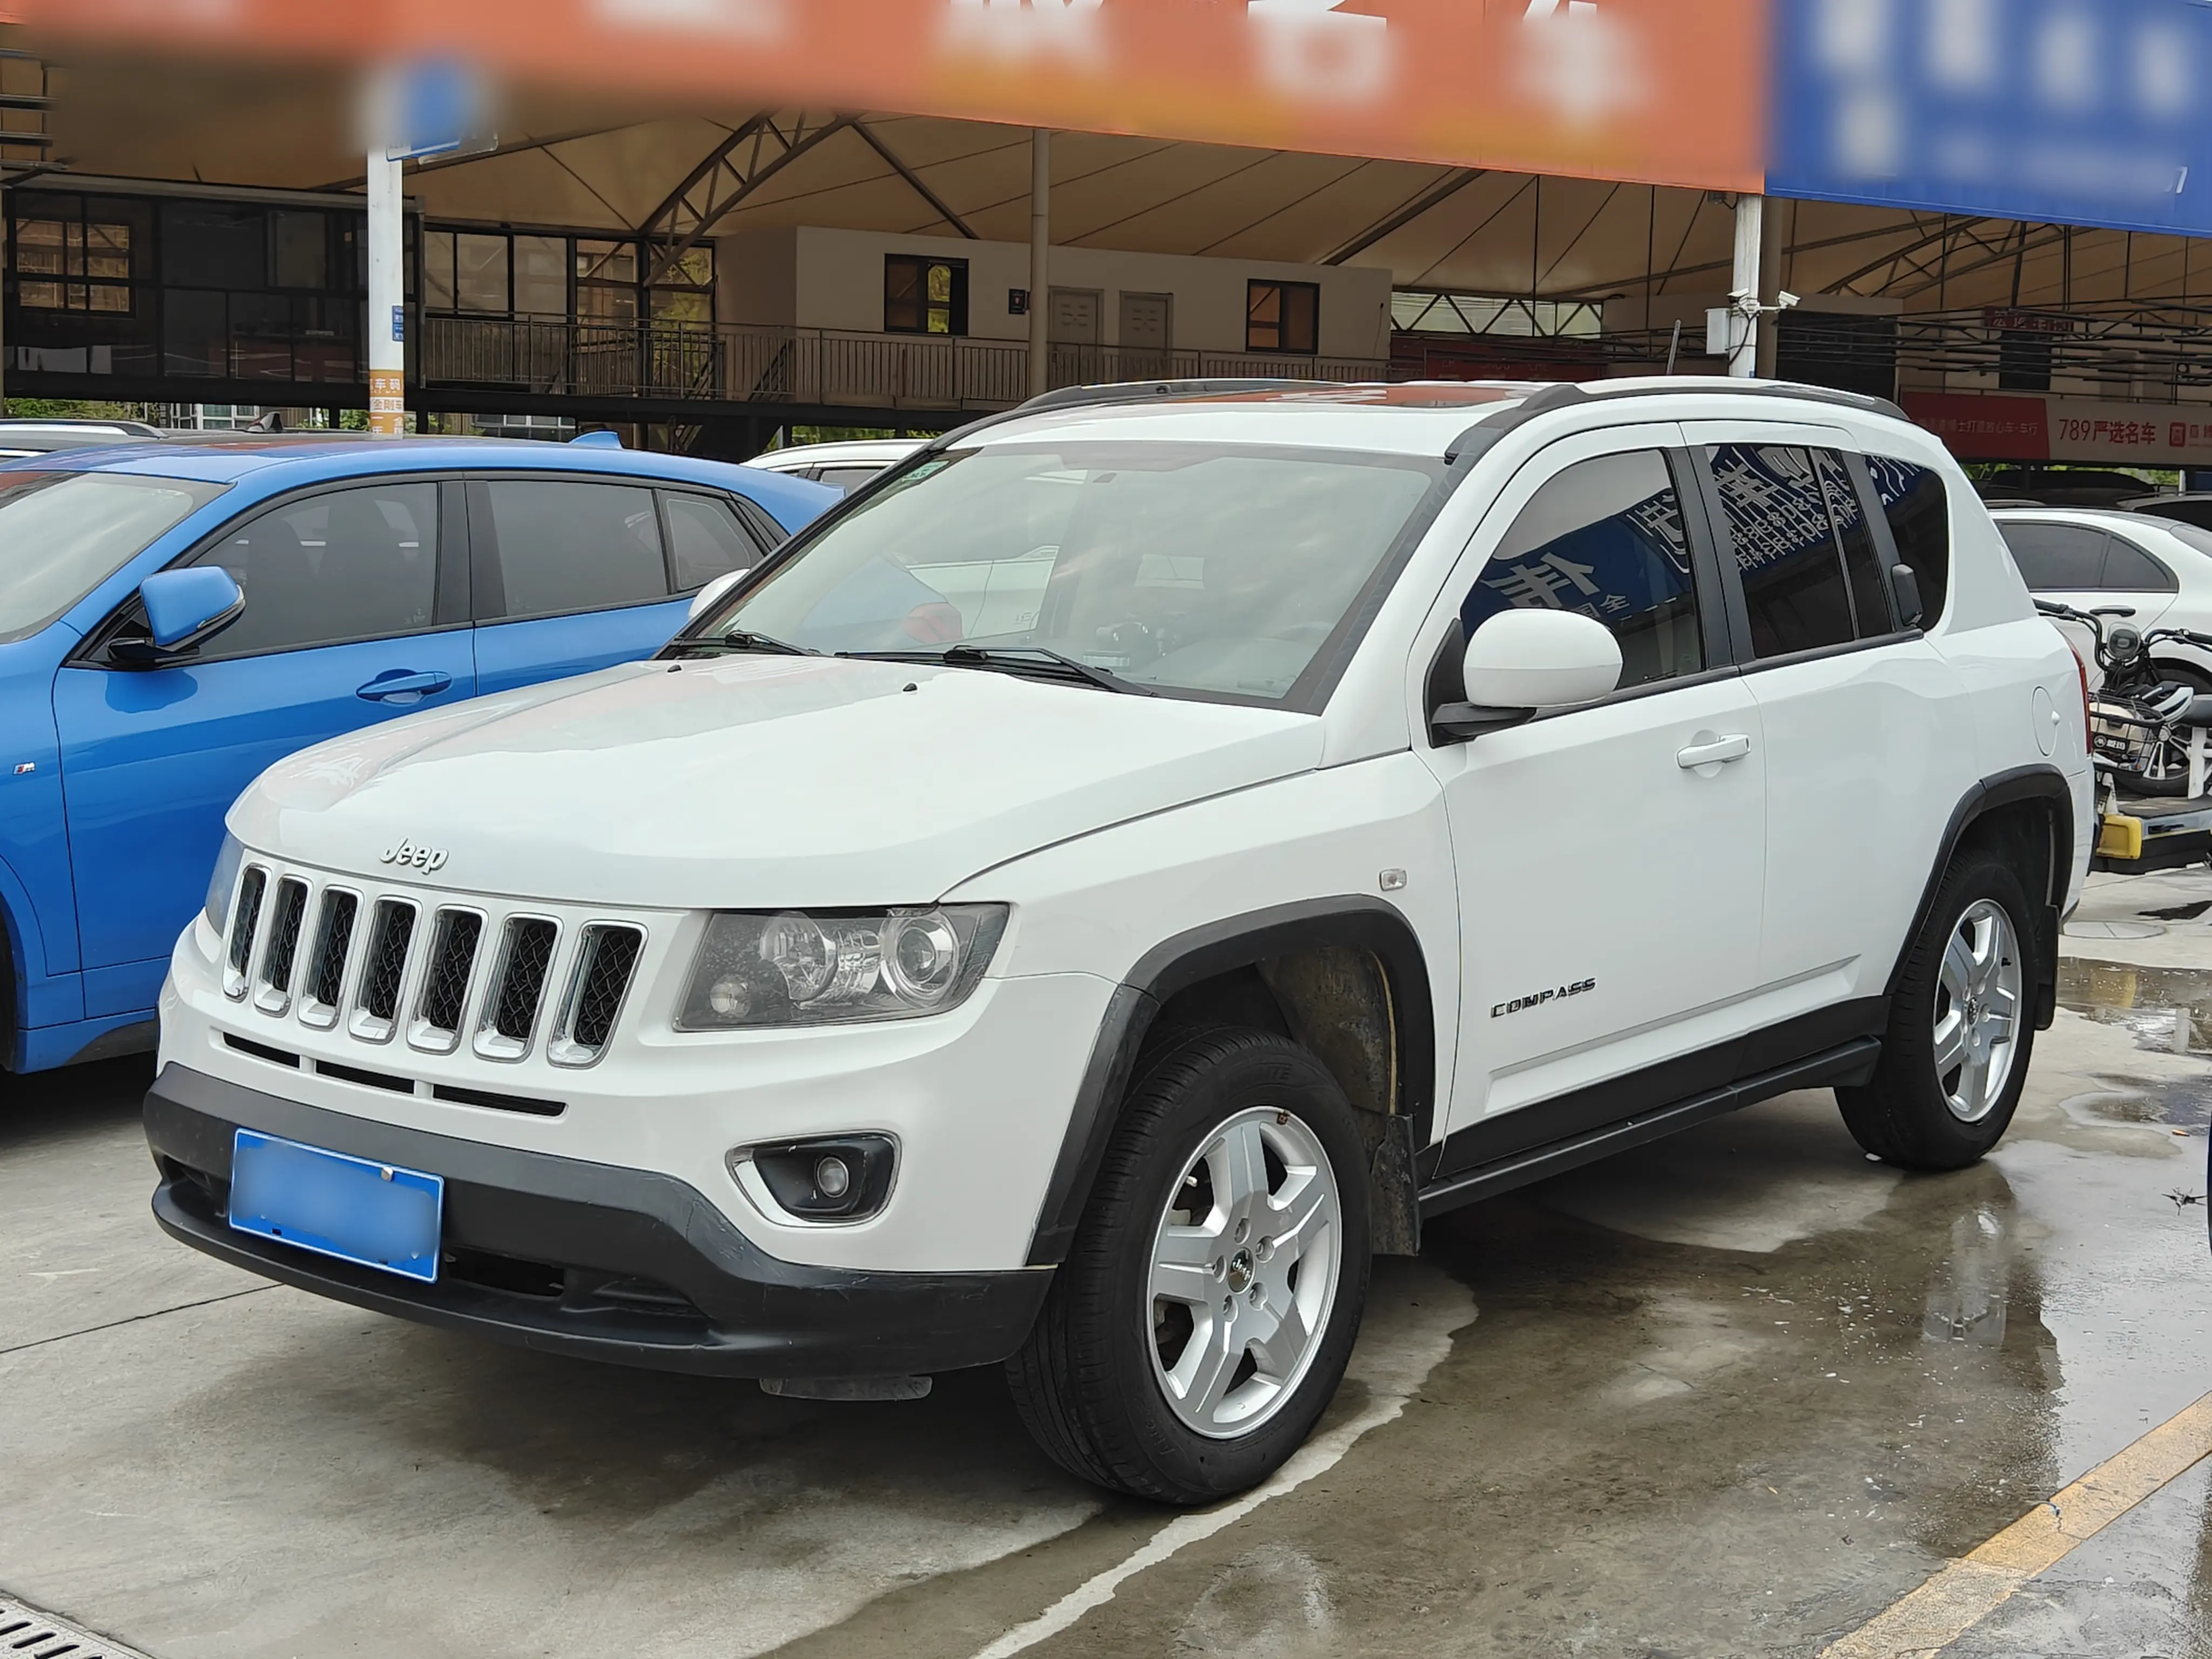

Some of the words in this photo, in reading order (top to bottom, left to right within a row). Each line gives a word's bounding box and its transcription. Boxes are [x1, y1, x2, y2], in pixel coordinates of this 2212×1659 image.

[2058, 419, 2156, 444] 789严选名车
[379, 837, 449, 876] Jeep
[1491, 977, 1595, 1019] COMPASS
